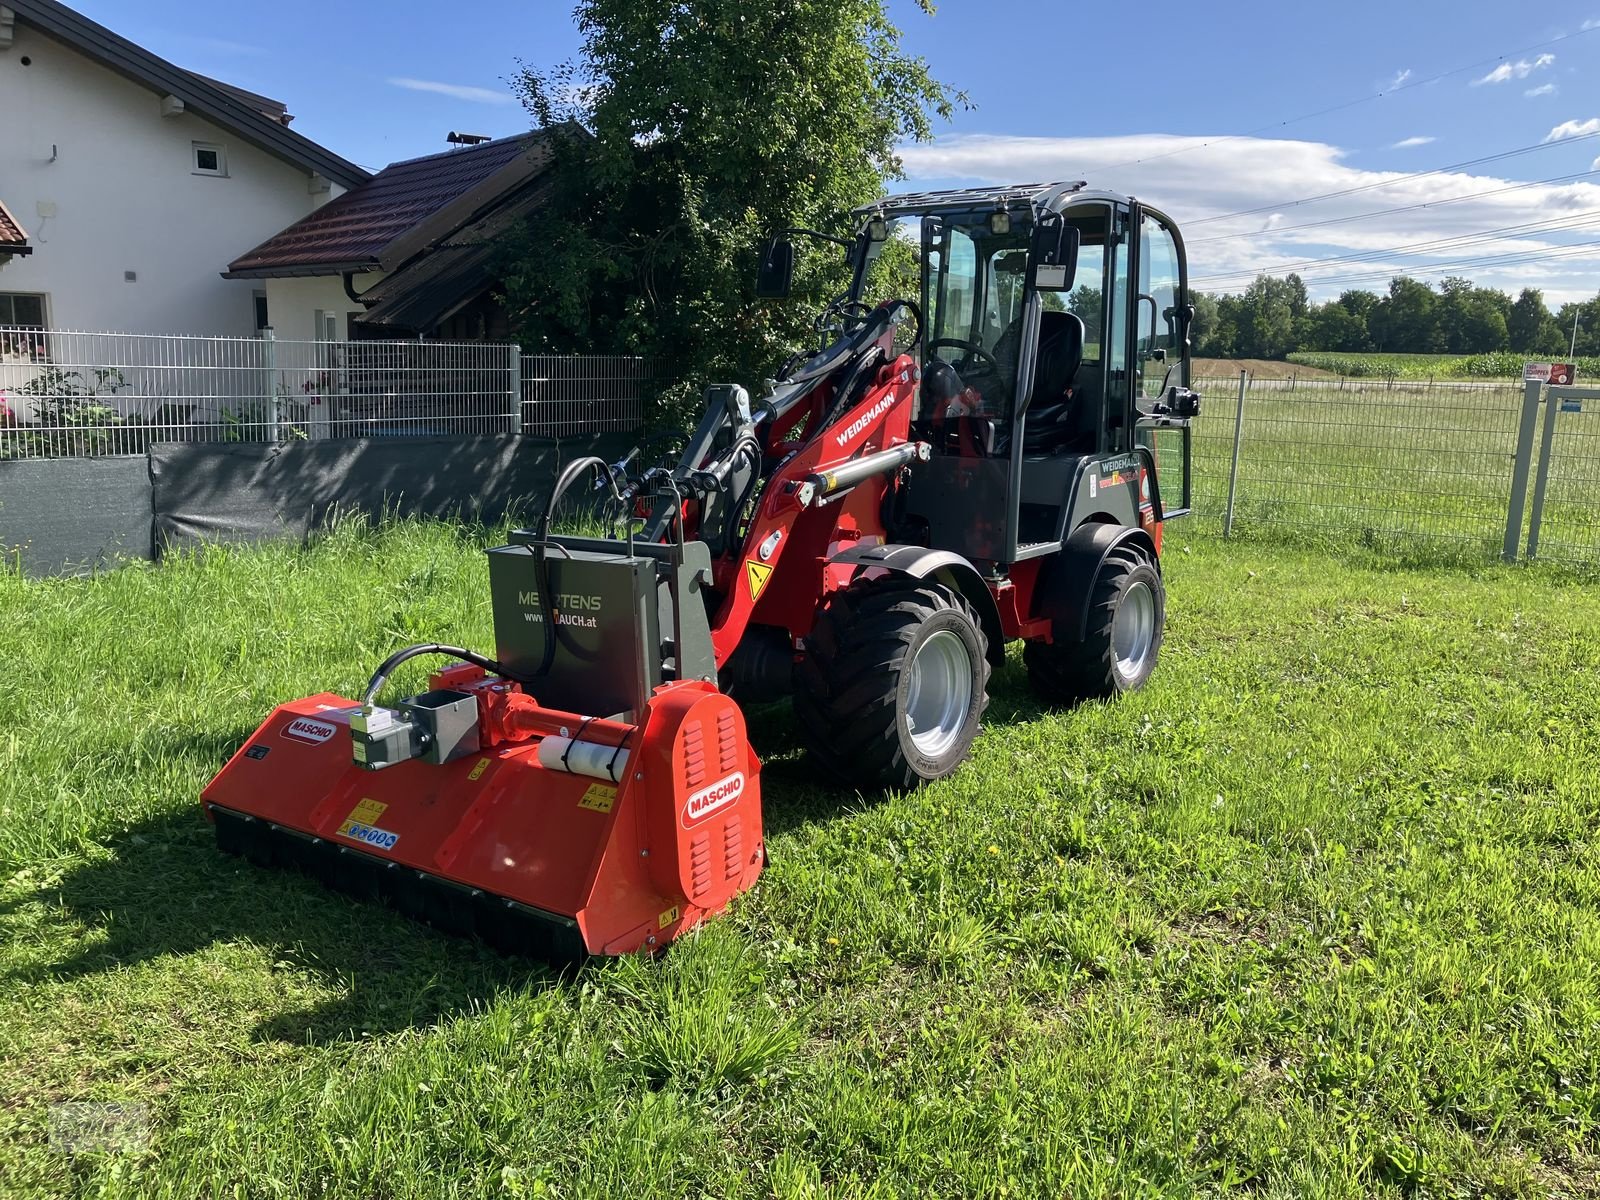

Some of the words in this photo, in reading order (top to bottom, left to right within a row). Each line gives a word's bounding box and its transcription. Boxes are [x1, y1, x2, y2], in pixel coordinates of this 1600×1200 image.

[836, 391, 895, 447] WEIDEMANN
[291, 721, 332, 738] MASCHIO
[690, 777, 741, 814] MASCHIO
